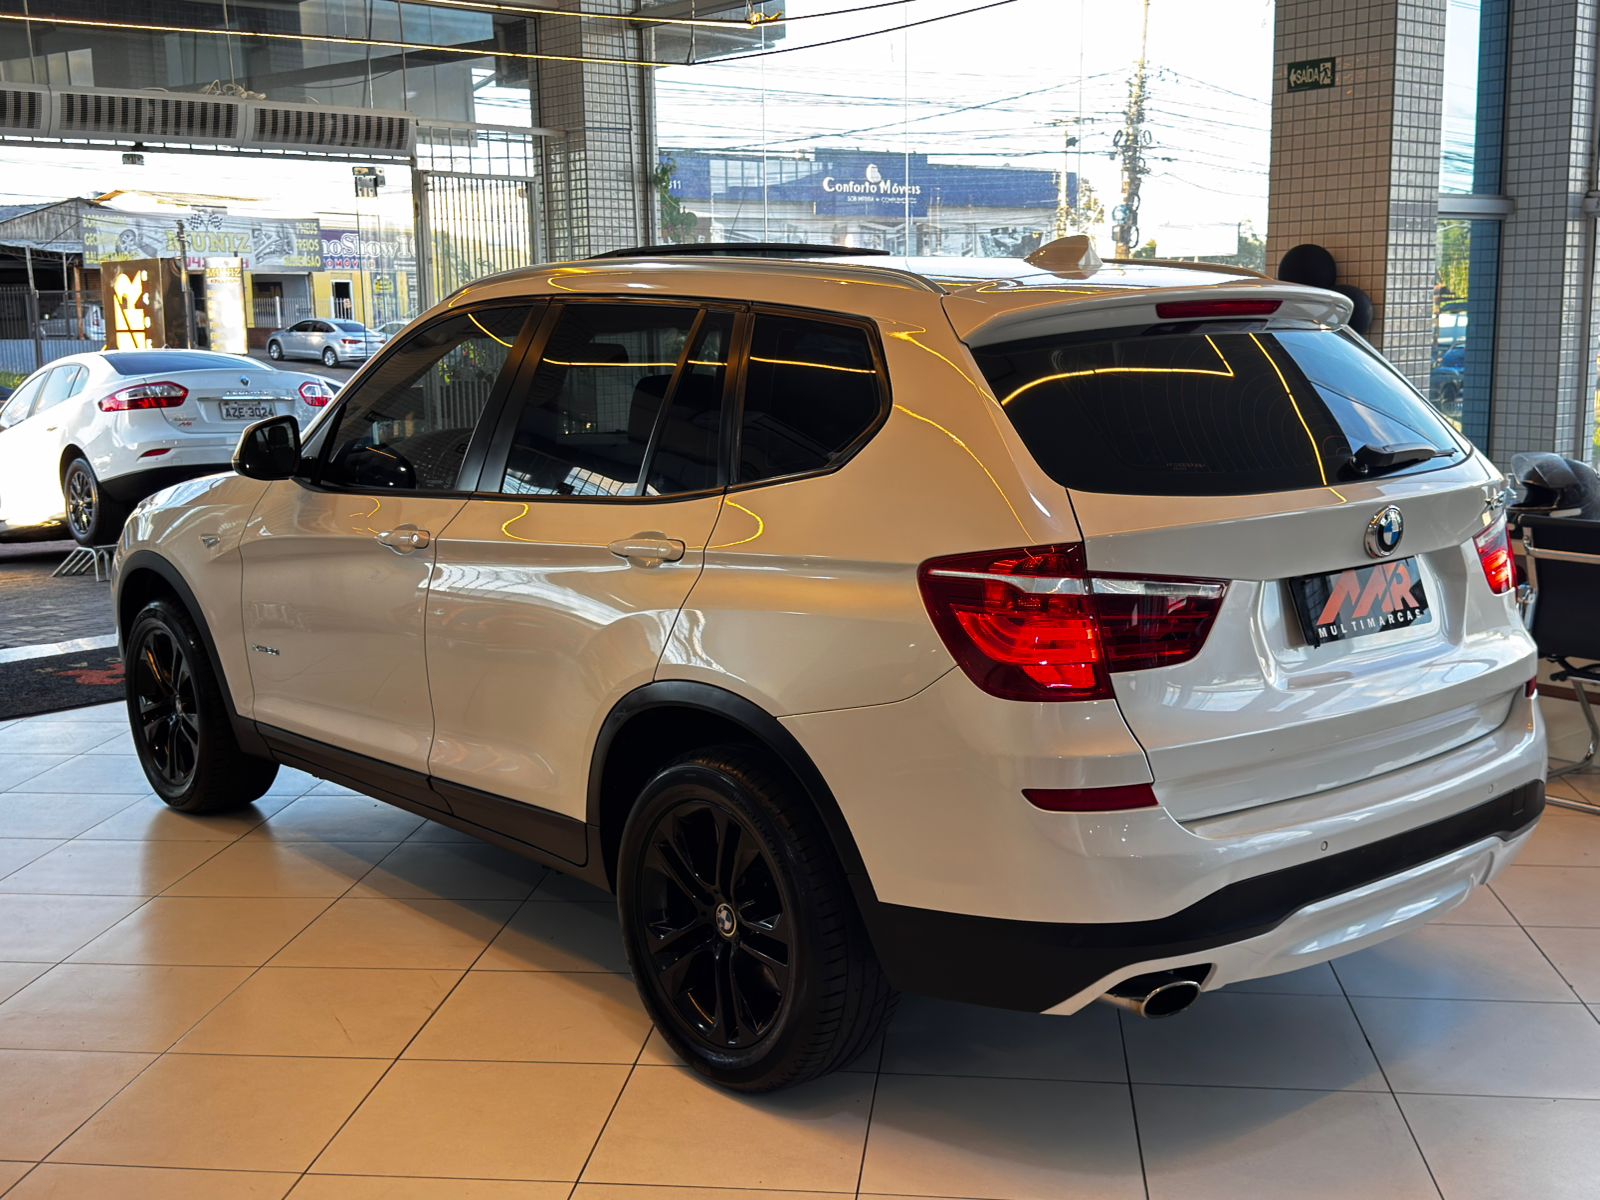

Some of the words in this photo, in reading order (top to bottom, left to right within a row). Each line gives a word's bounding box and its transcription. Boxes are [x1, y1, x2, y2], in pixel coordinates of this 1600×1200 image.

[1295, 65, 1319, 84] SAÍDA
[823, 177, 877, 193] Conforto
[225, 407, 275, 417] AZE-3024
[1318, 609, 1422, 638] MULTIMARCAS
